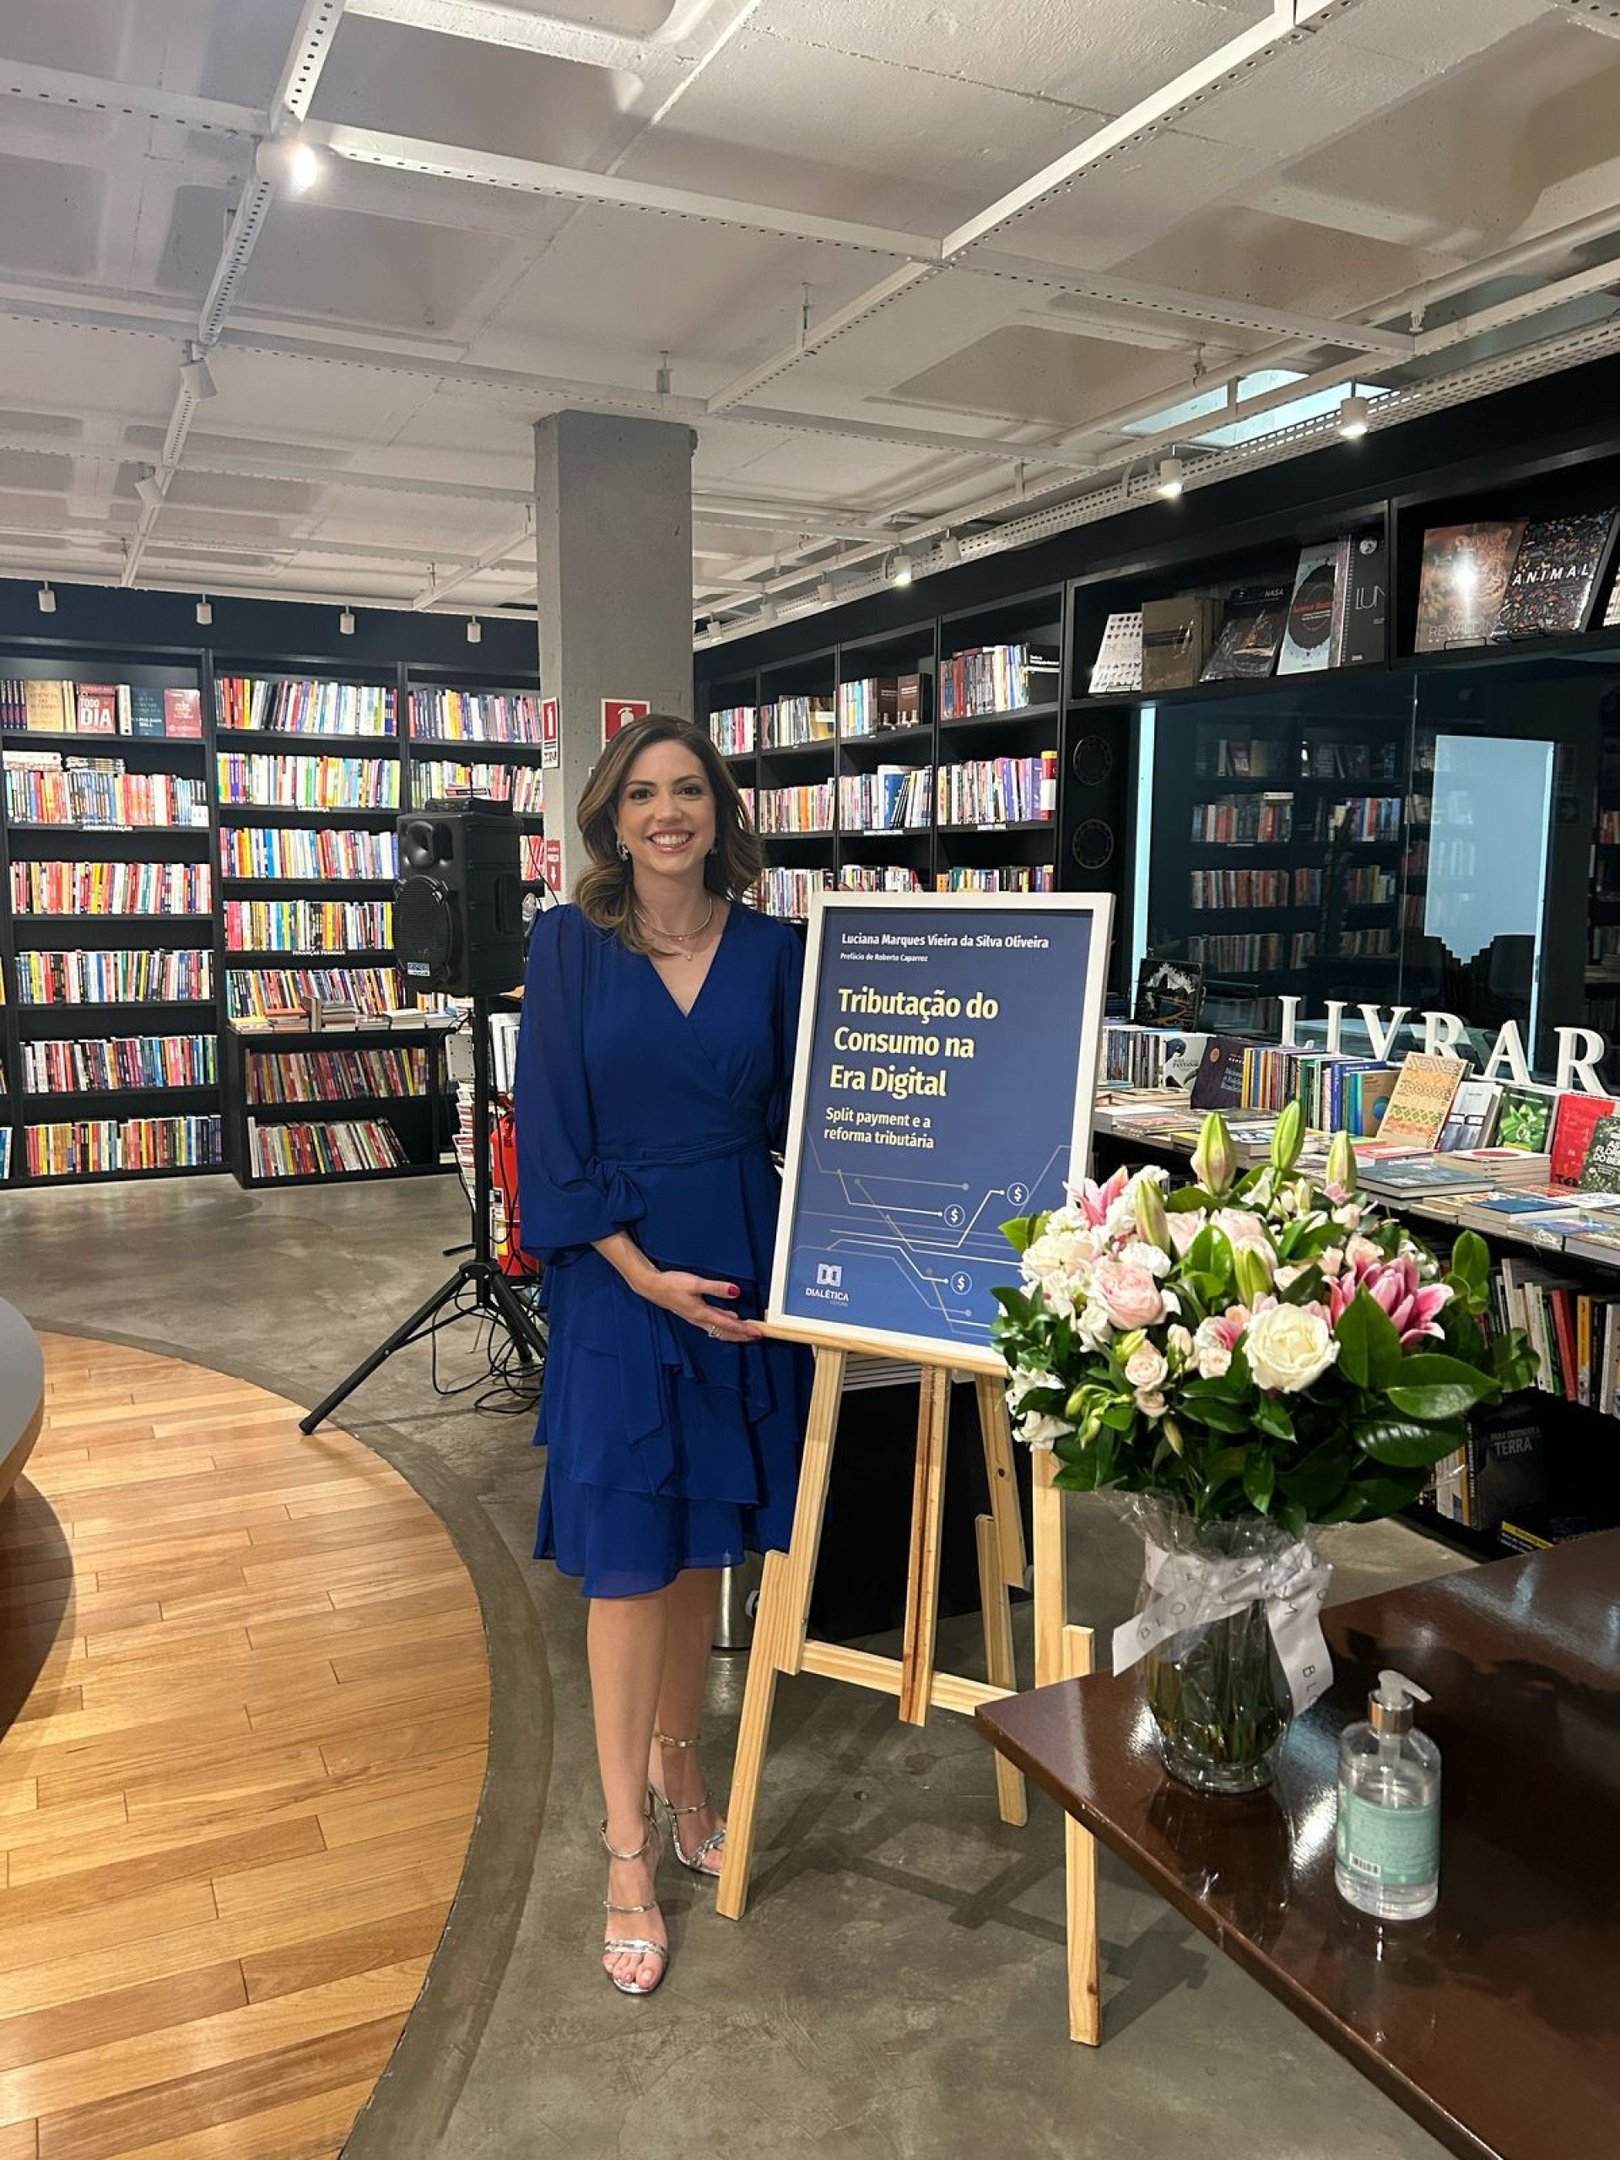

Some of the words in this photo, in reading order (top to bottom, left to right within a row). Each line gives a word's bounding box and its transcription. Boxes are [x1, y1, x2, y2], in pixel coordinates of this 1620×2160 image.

[1511, 563, 1590, 587] ANIMAL
[80, 708, 113, 726] DIA
[841, 932, 880, 945] Luciana
[881, 934, 926, 948] Marques
[927, 933, 958, 946] Vieira
[960, 934, 974, 947] da
[975, 933, 1003, 948] Silva
[1004, 935, 1050, 949] Oliveira
[840, 952, 865, 961] Prefácio
[865, 953, 874, 961] de
[874, 953, 900, 962] Roberto
[838, 985, 962, 1025] Tributação
[965, 991, 999, 1020] do
[834, 1026, 940, 1057] Consumo
[944, 1037, 975, 1059] na
[829, 1064, 866, 1091] Era
[870, 1064, 947, 1100] Digital
[825, 1106, 855, 1123] Split
[856, 1112, 911, 1127] payment
[912, 1117, 921, 1128] e
[922, 1118, 931, 1128] a
[823, 1127, 872, 1143] reforma
[874, 1130, 934, 1149] tributária
[805, 1287, 849, 1302] DIALÉTICA
[1493, 1437, 1534, 1457] TERRA
